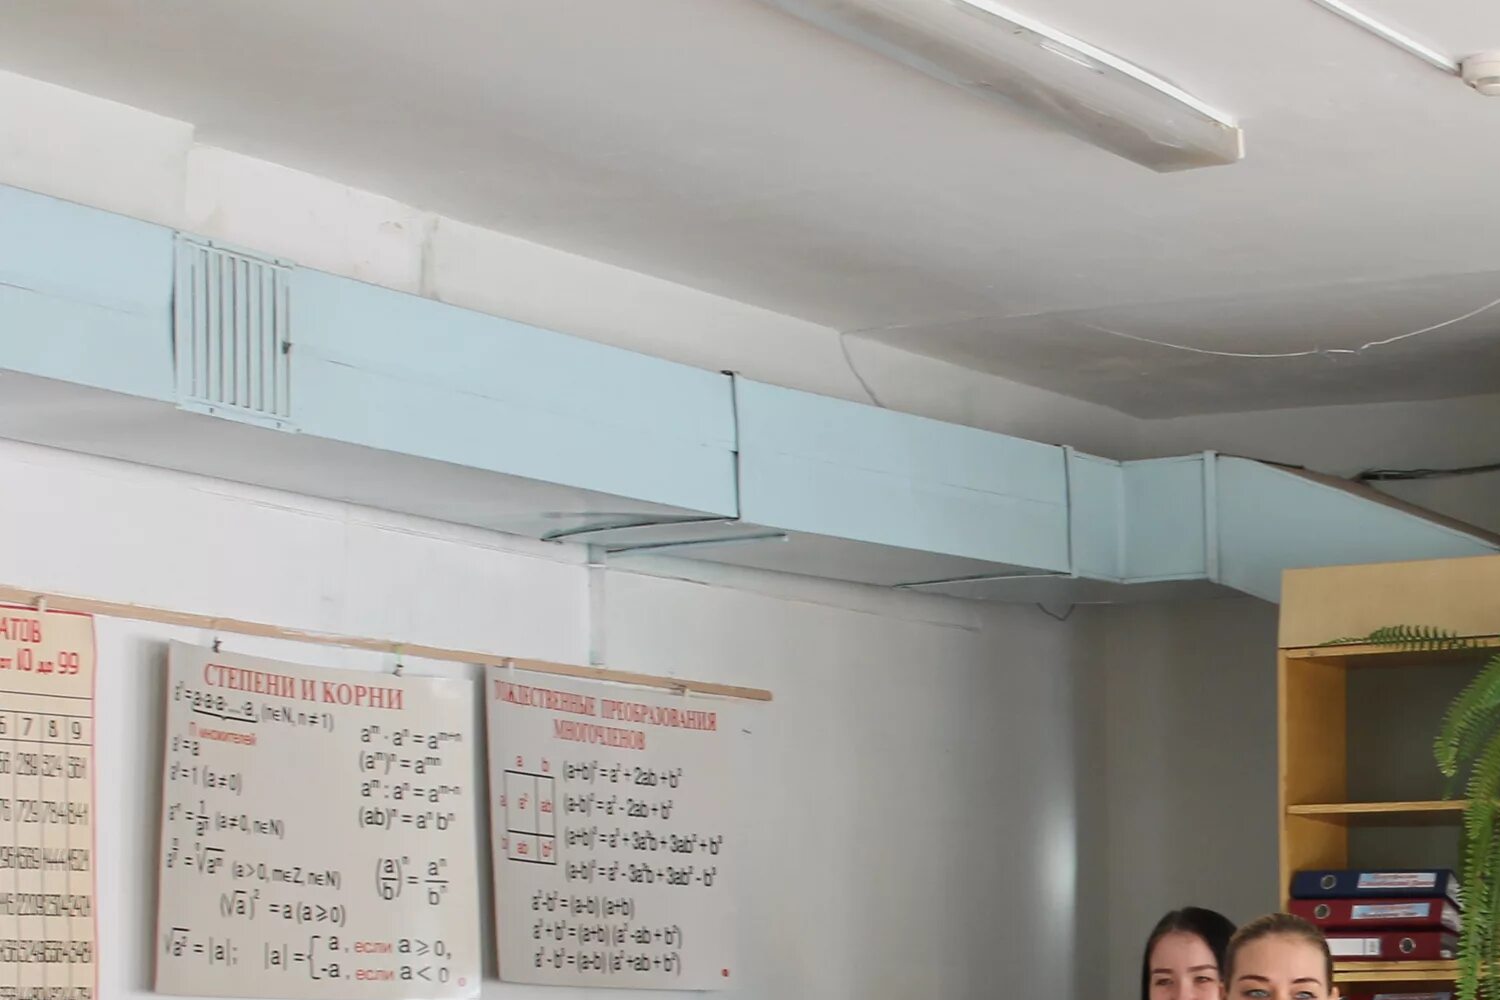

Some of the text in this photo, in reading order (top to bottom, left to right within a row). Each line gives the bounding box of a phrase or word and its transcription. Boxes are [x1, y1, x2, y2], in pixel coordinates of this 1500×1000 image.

[58, 651, 79, 674] 99
[204, 663, 404, 710] СТЕПЕНИ И КОРНИ
[22, 717, 33, 736] 7
[48, 719, 58, 738] 8
[71, 721, 82, 740] 9
[354, 941, 392, 954] если
[355, 969, 394, 981] если
